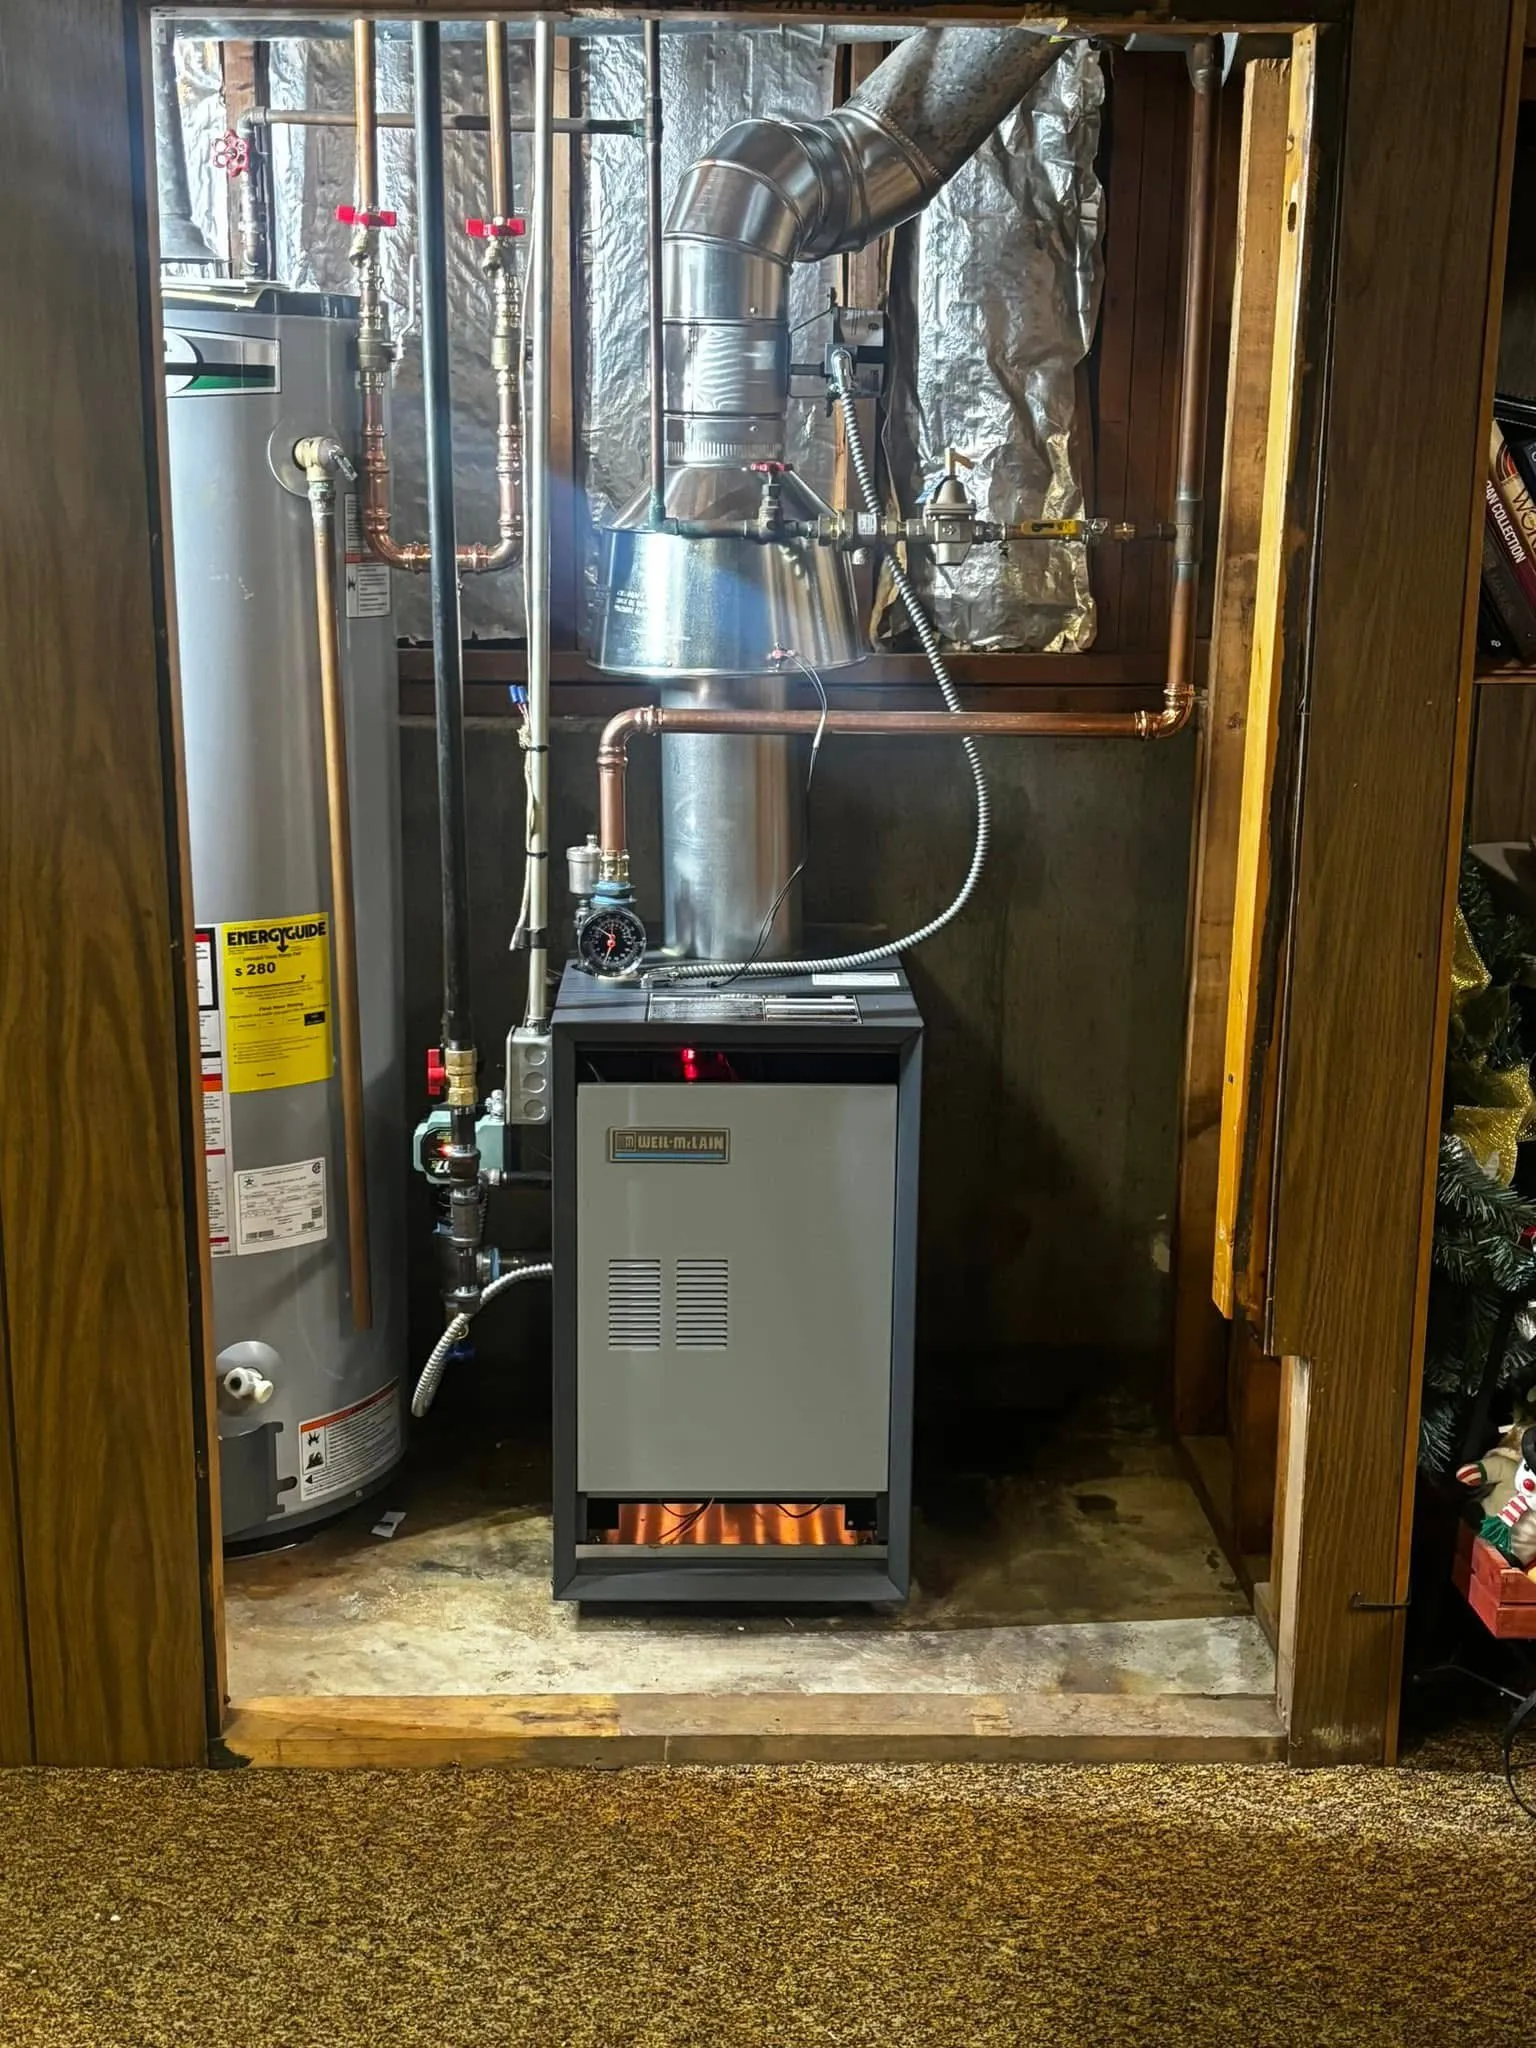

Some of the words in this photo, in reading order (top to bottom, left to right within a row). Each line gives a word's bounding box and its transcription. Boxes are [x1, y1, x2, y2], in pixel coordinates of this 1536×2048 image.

[1491, 502, 1526, 564] COLLECTION
[227, 921, 326, 948] ENERGYGUIDE
[246, 961, 276, 976] 280
